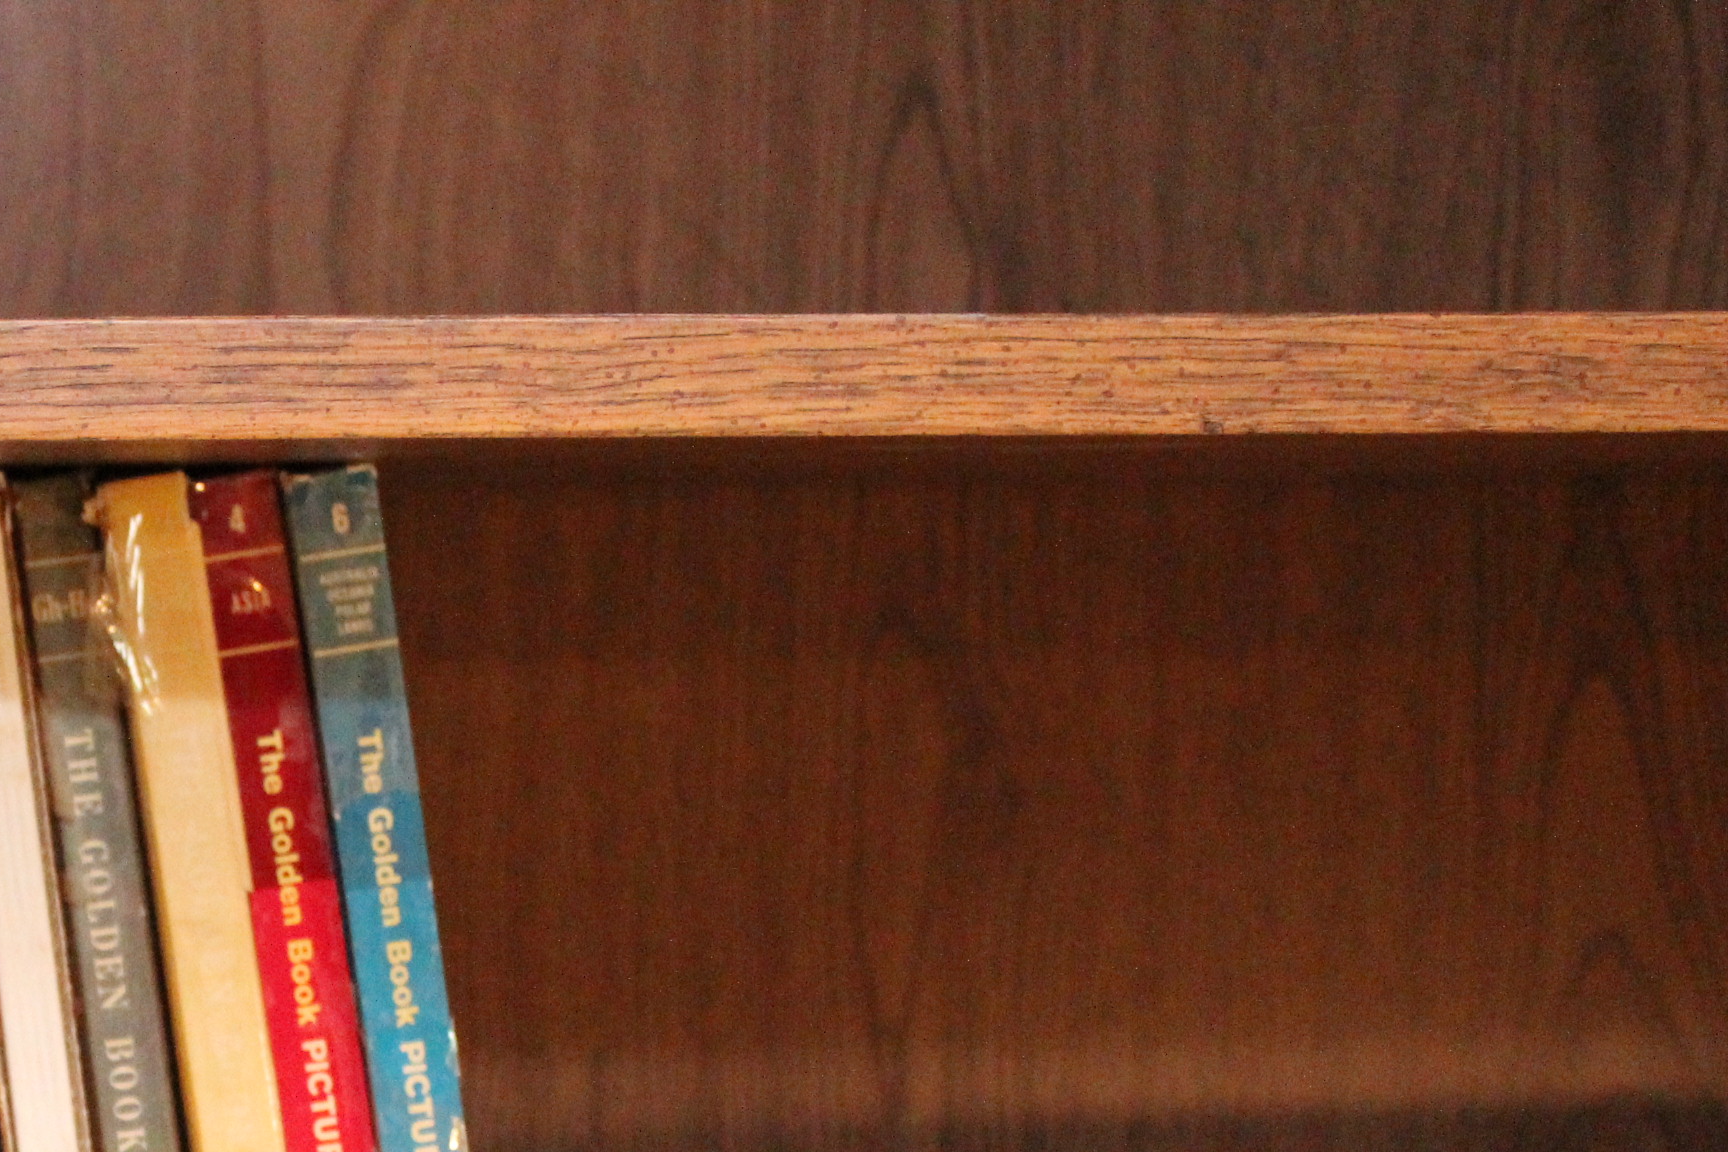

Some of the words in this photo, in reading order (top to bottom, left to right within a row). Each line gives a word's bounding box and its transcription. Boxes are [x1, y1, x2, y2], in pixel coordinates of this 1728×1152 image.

[230, 504, 246, 533] 4
[331, 502, 350, 534] 6
[231, 587, 271, 615] ASIA
[65, 728, 104, 818] THE
[257, 729, 285, 795] The
[358, 728, 384, 794] The
[268, 807, 304, 926] Golden
[367, 807, 403, 927] Golden
[78, 840, 128, 1010] GOLDEN
[287, 939, 323, 1027] Book
[386, 939, 420, 1028] Book
